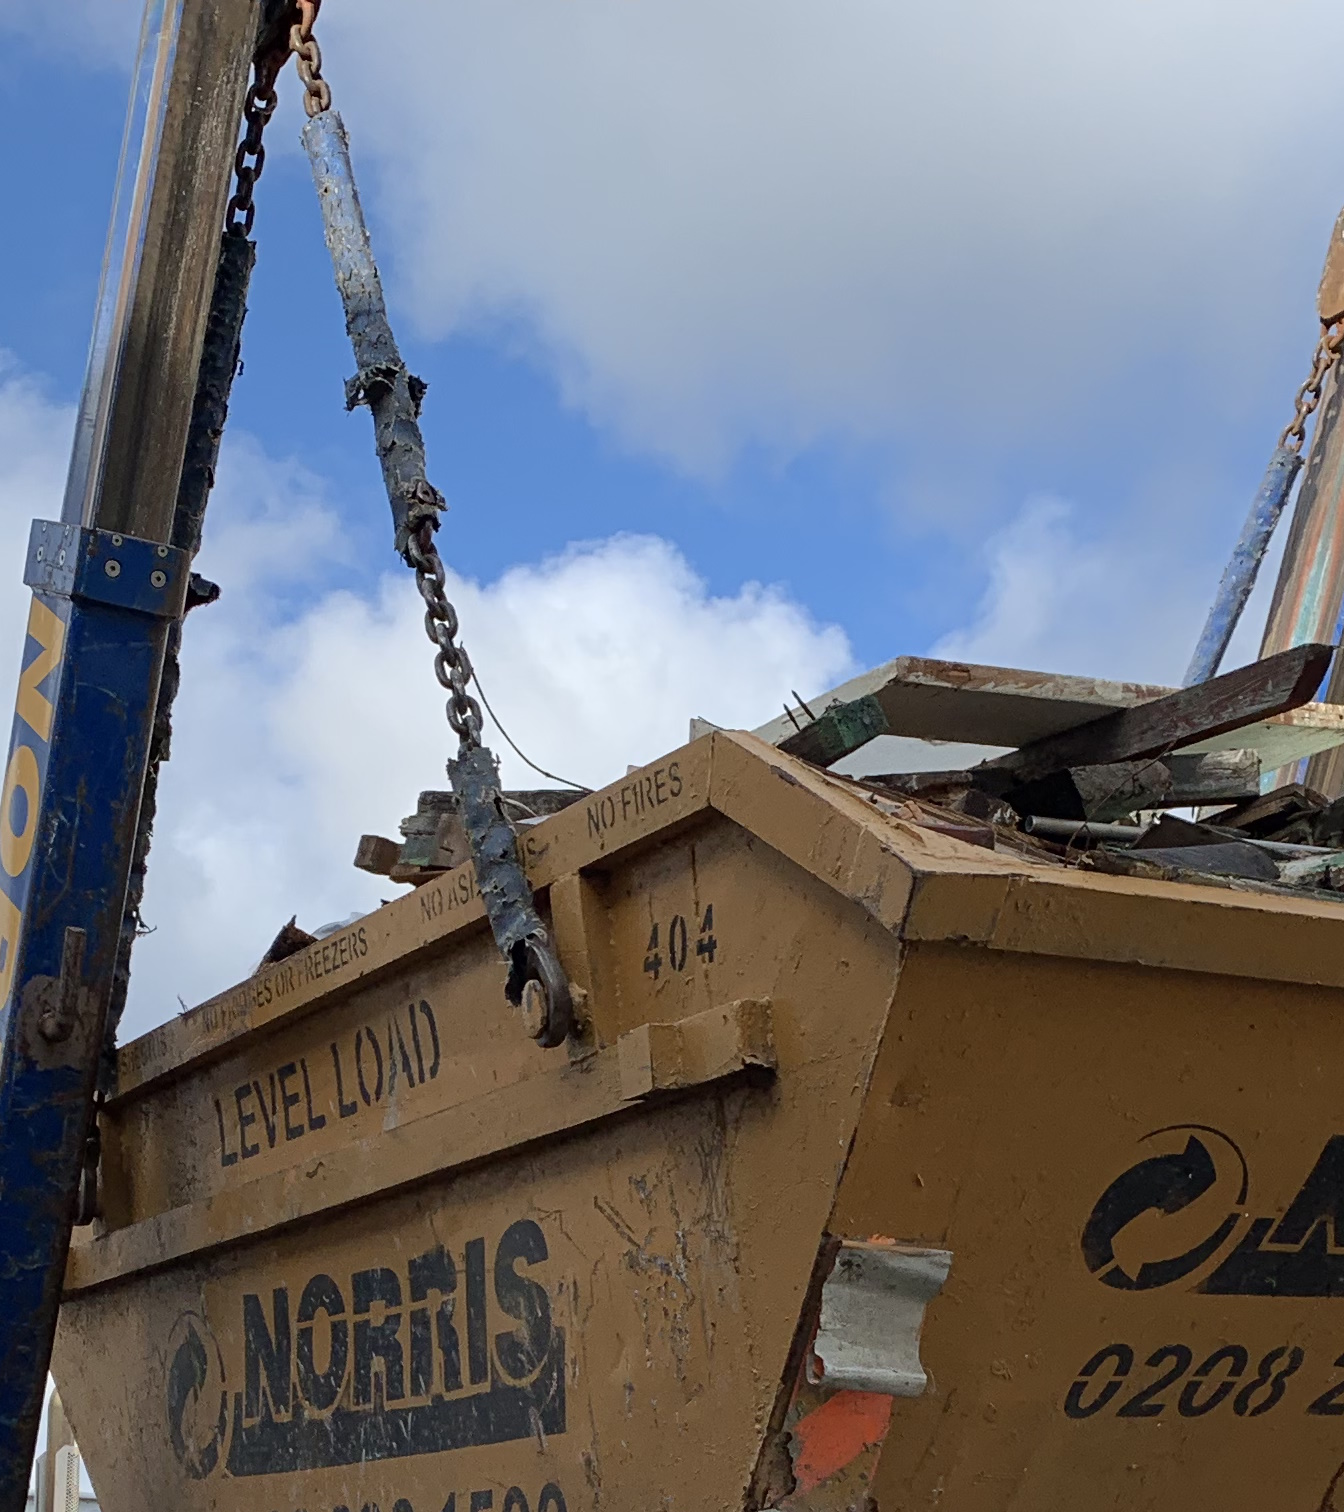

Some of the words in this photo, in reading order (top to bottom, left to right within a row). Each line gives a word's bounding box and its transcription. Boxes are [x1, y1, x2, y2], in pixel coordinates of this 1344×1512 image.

[587, 796, 616, 838] NO
[621, 762, 683, 821] FIRES
[420, 887, 443, 924] NO
[642, 903, 718, 980] 404
[275, 966, 296, 998] OR
[297, 926, 369, 988] FREEZERS
[213, 1042, 327, 1168] LEVEL
[329, 999, 441, 1120] LOAD
[242, 1219, 549, 1423] NORRIS
[1063, 1343, 1304, 1419] 0208
